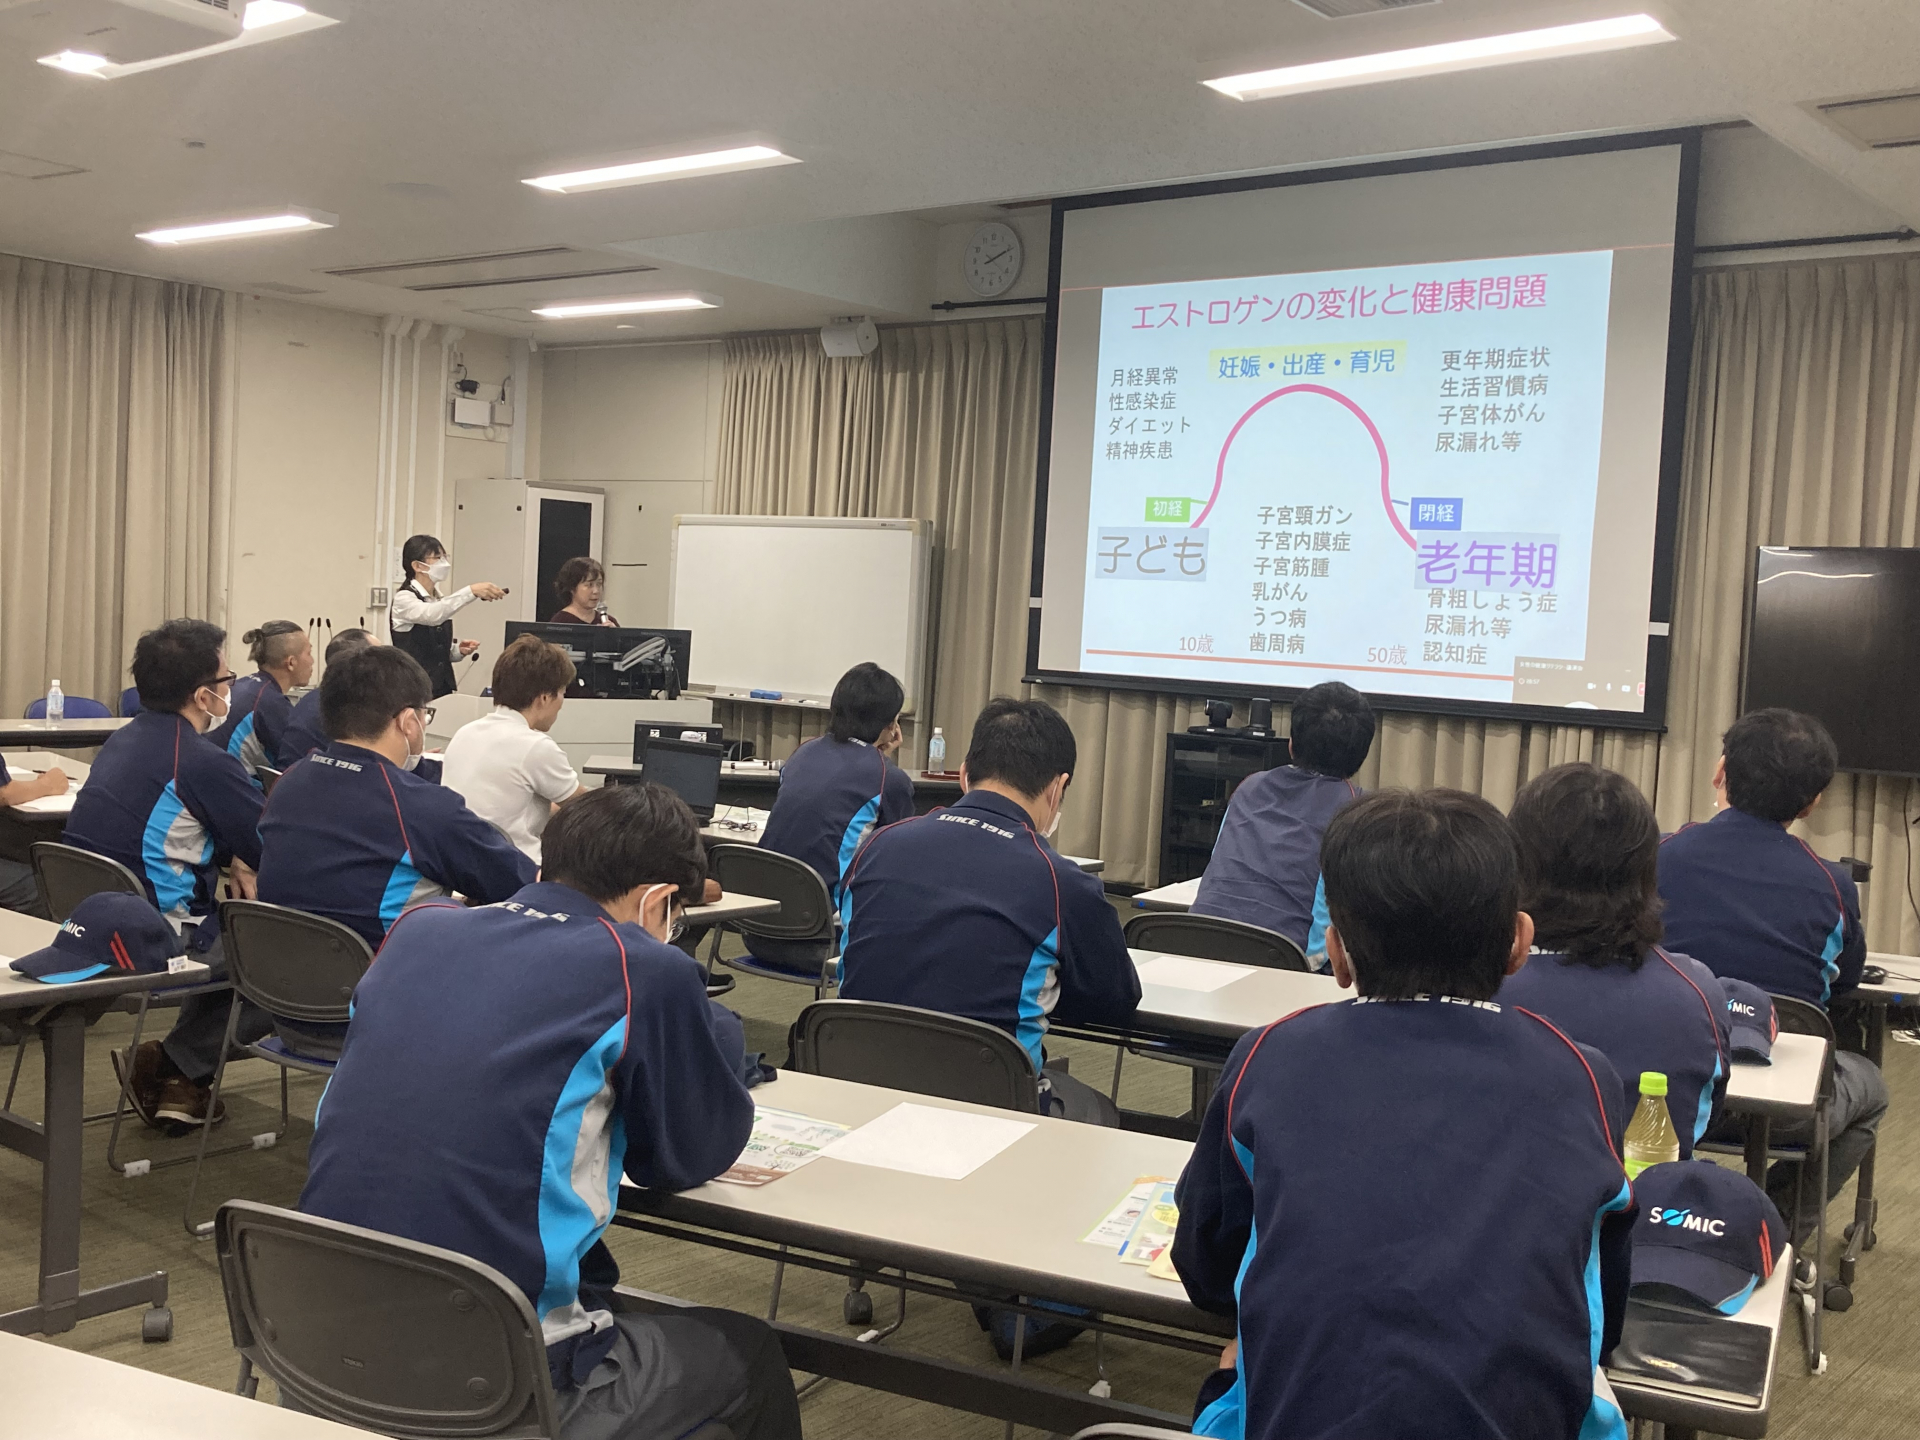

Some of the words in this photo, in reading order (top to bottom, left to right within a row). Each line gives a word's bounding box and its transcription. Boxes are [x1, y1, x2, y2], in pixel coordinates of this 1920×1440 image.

[1131, 273, 1548, 329] エストロゲンの変化と健康問題
[1217, 348, 1396, 379] 妊娠・出産・育児
[1440, 346, 1551, 372] 更年期症状
[1110, 366, 1178, 388] 月経異常
[1439, 373, 1549, 398] 生活習慣病
[1108, 391, 1177, 411] 性感染症
[1437, 402, 1546, 425] 子宮体がん
[1107, 416, 1191, 435] ダイエット
[1105, 440, 1173, 461] 精神疾患
[1435, 430, 1522, 453] 尿漏れ等
[1152, 500, 1183, 517] 初経
[1418, 503, 1455, 523] 閉経
[1255, 530, 1352, 552] 子宮内膜症
[1098, 534, 1206, 576] 子ども
[1417, 539, 1558, 589] 老年期
[1253, 556, 1330, 578] 子宮筋腫
[1251, 582, 1308, 602] 乳がん
[1427, 587, 1558, 613] 骨粗しょう症
[1252, 606, 1307, 628] うつ病
[1424, 614, 1512, 639] 尿漏れ等
[1178, 633, 1215, 654] 10歳
[1249, 632, 1306, 654] 歯周病
[1366, 643, 1408, 666] 50歳
[1422, 641, 1488, 666] 認知症
[936, 813, 980, 827] SINCE
[980, 821, 1015, 839] 1916
[1649, 1206, 1726, 1236] SOMIC
